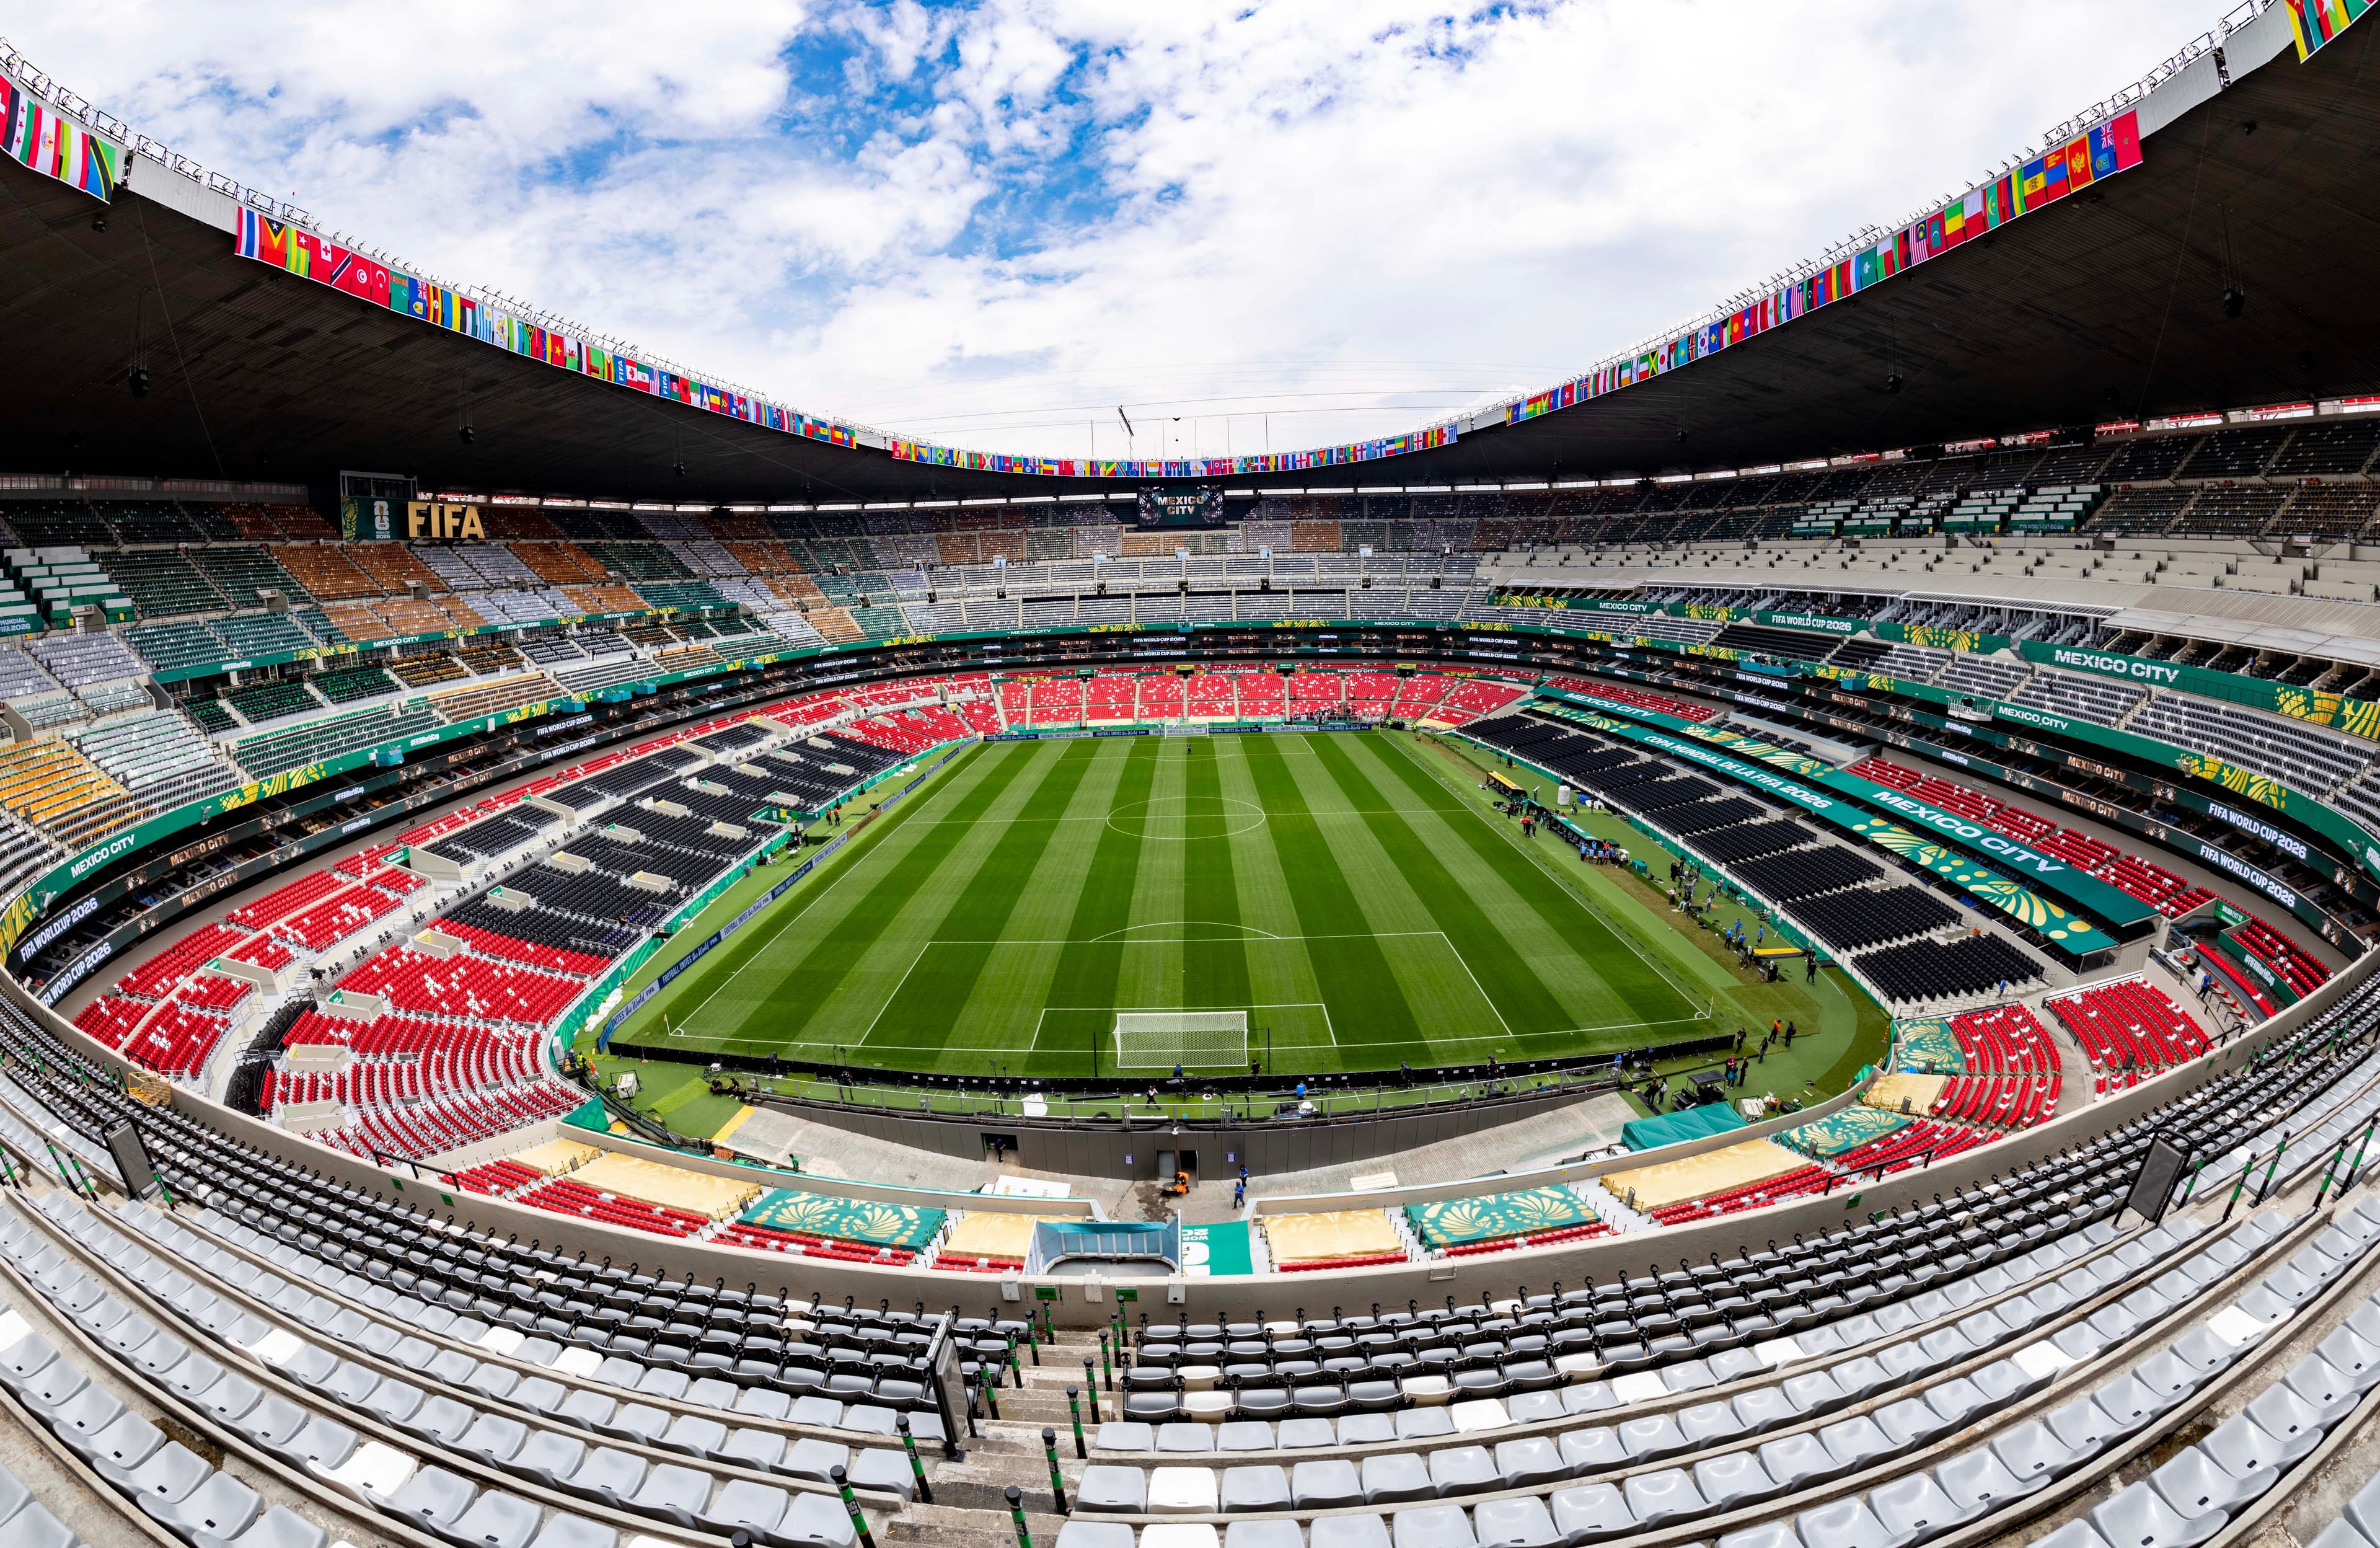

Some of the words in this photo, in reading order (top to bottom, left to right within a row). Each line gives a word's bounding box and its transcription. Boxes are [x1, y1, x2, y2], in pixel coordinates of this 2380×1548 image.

[1157, 496, 1204, 505] MEXICO
[1167, 506, 1196, 515] CITY
[408, 501, 485, 539] FIFA
[1600, 602, 1628, 611] MEXICO
[0, 617, 26, 626] MUNDIAL
[11, 623, 31, 631] 2026
[1772, 614, 1786, 624] FIFA
[1786, 616, 1811, 626] WORLD
[1812, 618, 1826, 628] CUP
[1827, 621, 1851, 632] 2026
[373, 638, 402, 648] MEXICO
[684, 669, 705, 678] MEXICO
[2055, 649, 2127, 673] MEXICO
[2131, 663, 2179, 683] CITY
[1745, 674, 1761, 684] WORLD
[1761, 678, 1771, 686] CUP
[1771, 680, 1788, 689] 2026
[1564, 693, 1618, 708] MEXICO
[1616, 702, 1656, 717] CITY
[1744, 696, 1760, 705] WORLD
[1760, 699, 1770, 707] CUP
[1770, 702, 1786, 712] 2026
[1831, 693, 1854, 705] MEXICO
[1854, 698, 1867, 707] CITY
[537, 727, 548, 736] FIFA
[548, 723, 566, 733] WORLD
[566, 719, 576, 728] CUP
[576, 715, 593, 725] 2026
[1829, 717, 1852, 729] MEXICO
[1852, 723, 1866, 733] CITY
[1998, 705, 2040, 722] MEXICO
[2042, 717, 2069, 730] CITY
[447, 749, 474, 763] MEXICO
[474, 745, 488, 755] CITY
[540, 752, 552, 760] FIFA
[552, 746, 570, 757] WORLD
[570, 743, 580, 751] CUP
[580, 737, 596, 748] 2026
[1644, 736, 1675, 749] COPA
[1670, 743, 1722, 766] MUNDIAL
[1718, 760, 1740, 771] DE
[1734, 766, 1756, 779] LA
[1755, 774, 1784, 788] FIFA
[1779, 785, 1833, 808] 2026
[2067, 755, 2102, 774] MEXICO
[2104, 767, 2126, 782] CITY
[453, 777, 478, 792] MEXICO
[478, 771, 493, 782] CITY
[2061, 790, 2097, 810] MEXICO
[2097, 803, 2119, 819] CITY
[1872, 791, 1982, 838] MEXICO
[1980, 836, 2065, 872] CITY
[2208, 802, 2228, 820] FIFA
[2229, 810, 2260, 834] WORLD
[2260, 825, 2278, 842] CUP
[2277, 834, 2307, 859] 2026
[70, 849, 110, 878] MEXICO
[110, 834, 134, 854] CITY
[170, 843, 207, 867] MEXICO
[207, 833, 229, 850] CITY
[2200, 844, 2219, 862] FIFA
[2219, 853, 2250, 878] WORLD
[2250, 871, 2268, 888] CUP
[2267, 880, 2295, 908] 2026
[181, 882, 218, 907] MEXICO
[218, 871, 238, 888] CITY
[20, 941, 37, 962] FIFA
[33, 922, 60, 951] WORLD
[71, 897, 98, 922] 2026
[71, 961, 86, 980] CUP
[85, 942, 112, 970] 2026
[663, 966, 679, 984] FOOTBALL
[679, 955, 692, 970] UNITES
[698, 941, 709, 957] World
[710, 937, 718, 945] FIFA
[632, 993, 645, 1011] World
[646, 988, 654, 997] FIFA
